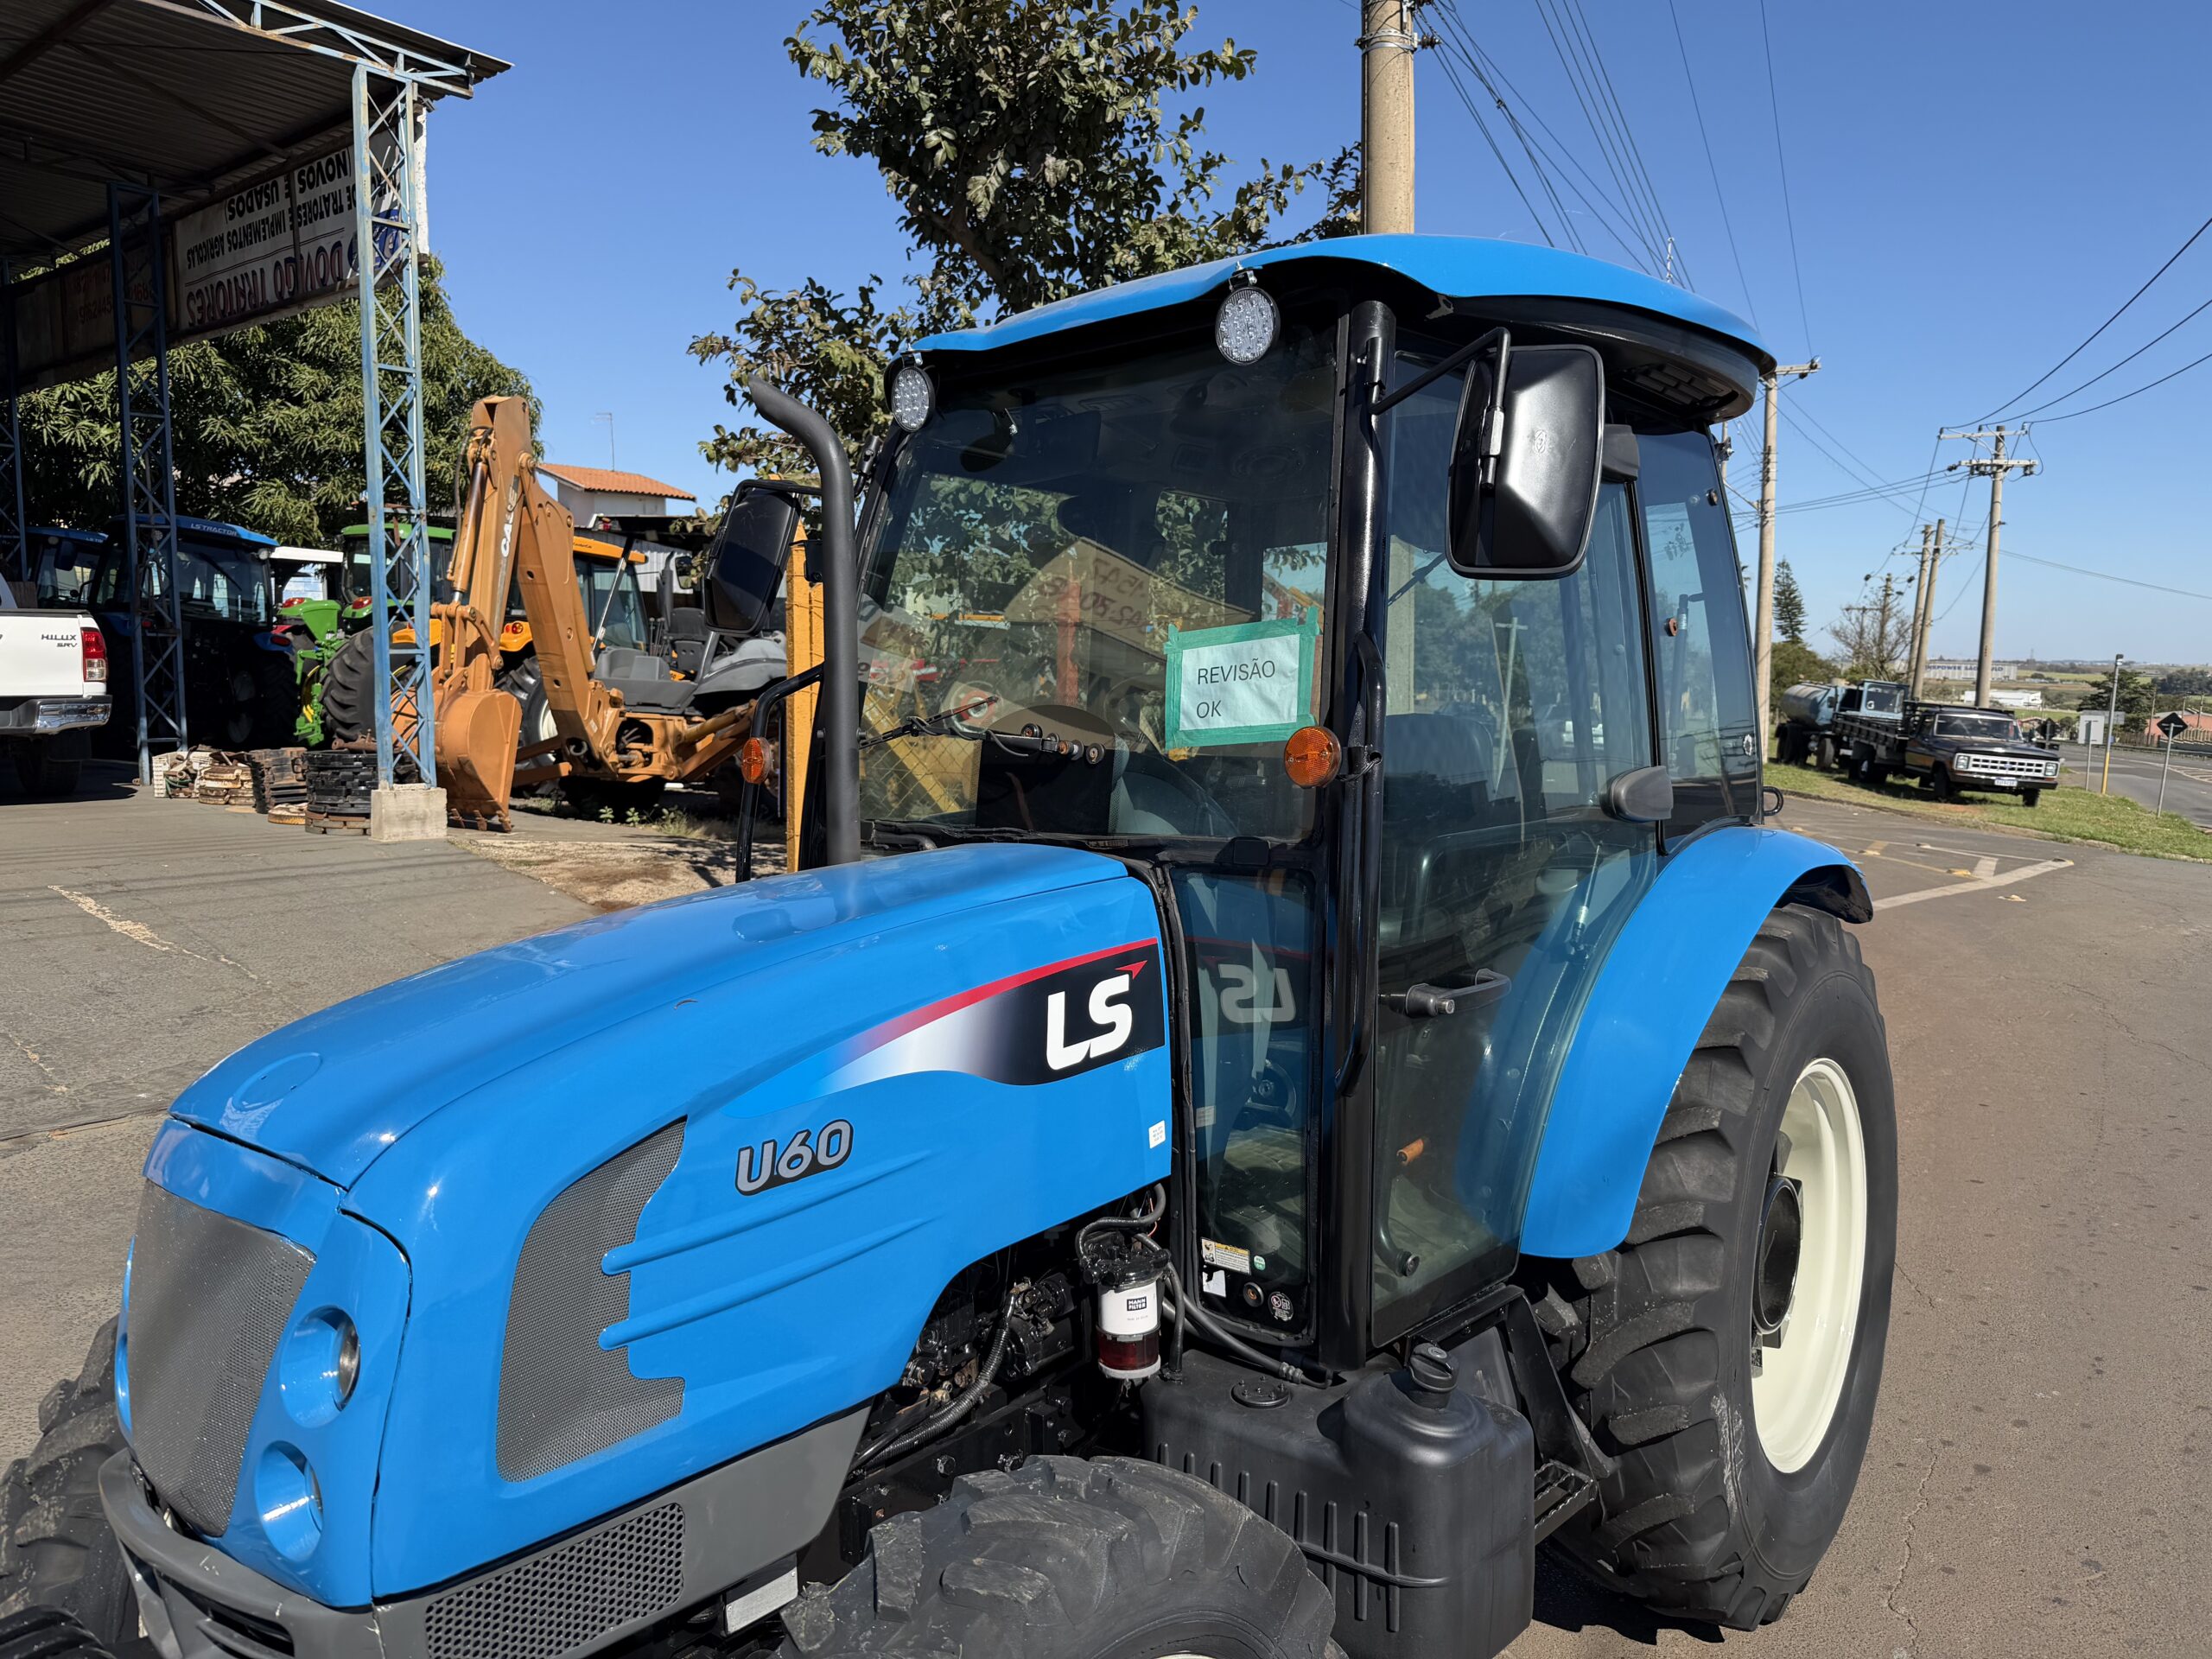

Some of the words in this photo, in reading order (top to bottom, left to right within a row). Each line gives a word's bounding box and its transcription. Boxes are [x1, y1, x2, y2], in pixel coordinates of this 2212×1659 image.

[298, 190, 344, 226] TRATORES
[227, 210, 286, 253] IMPLEMENTOS
[202, 524, 238, 537] TRACTOR
[1198, 658, 1275, 685] REVISÃO
[1196, 700, 1222, 719] OK
[1046, 974, 1133, 1071] LS
[735, 1119, 854, 1196] U60
